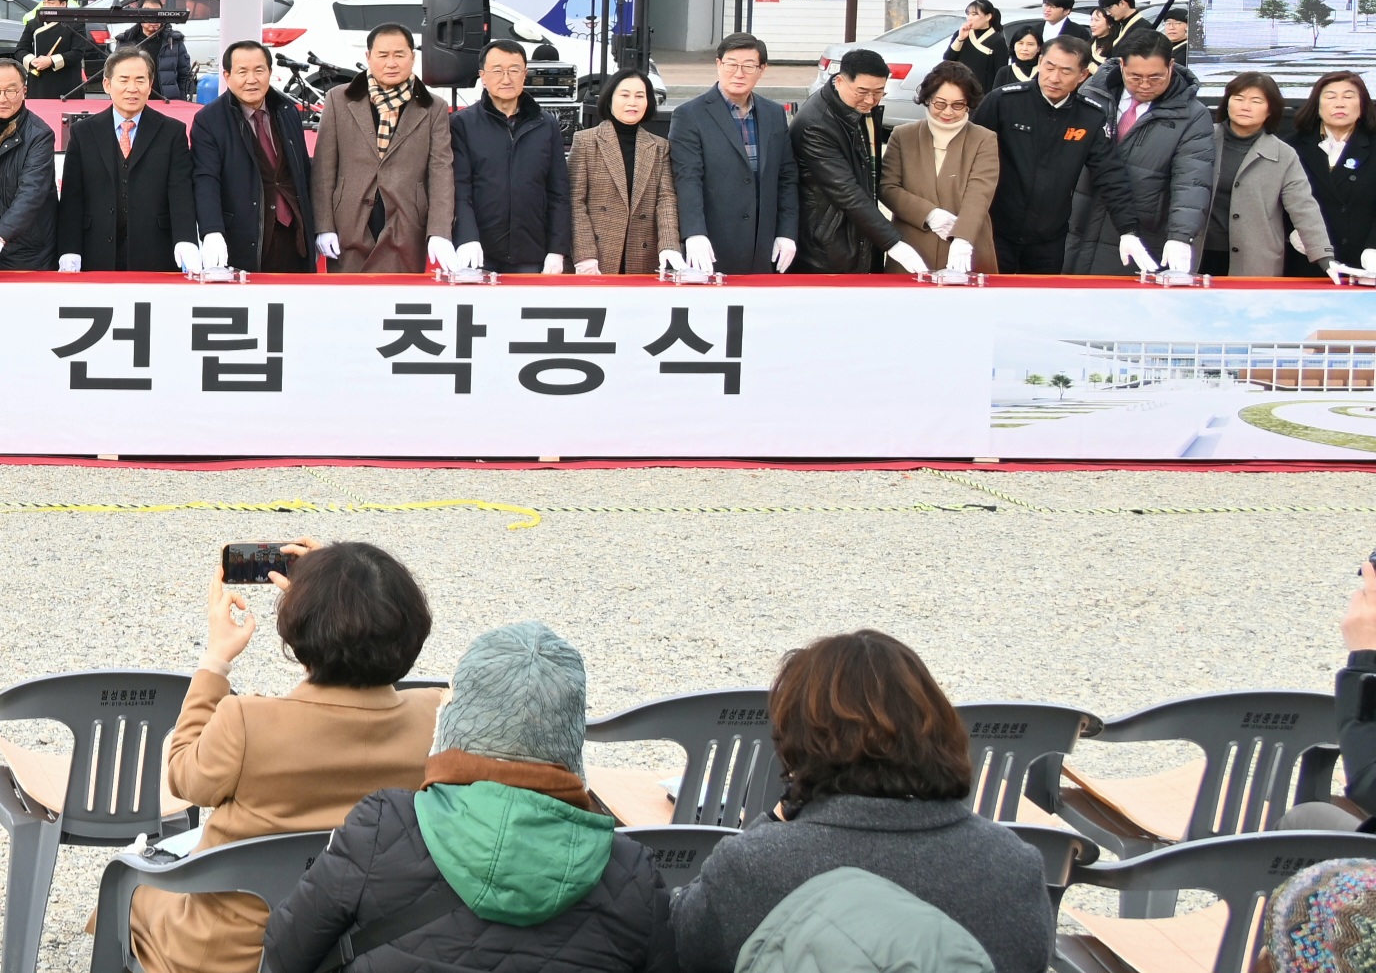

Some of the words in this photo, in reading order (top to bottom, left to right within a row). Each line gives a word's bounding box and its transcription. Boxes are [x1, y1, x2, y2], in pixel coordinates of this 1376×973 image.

[51, 302, 284, 392] 건립
[376, 302, 745, 396] 착공식
[101, 689, 156, 701] 칠성종합렌탈
